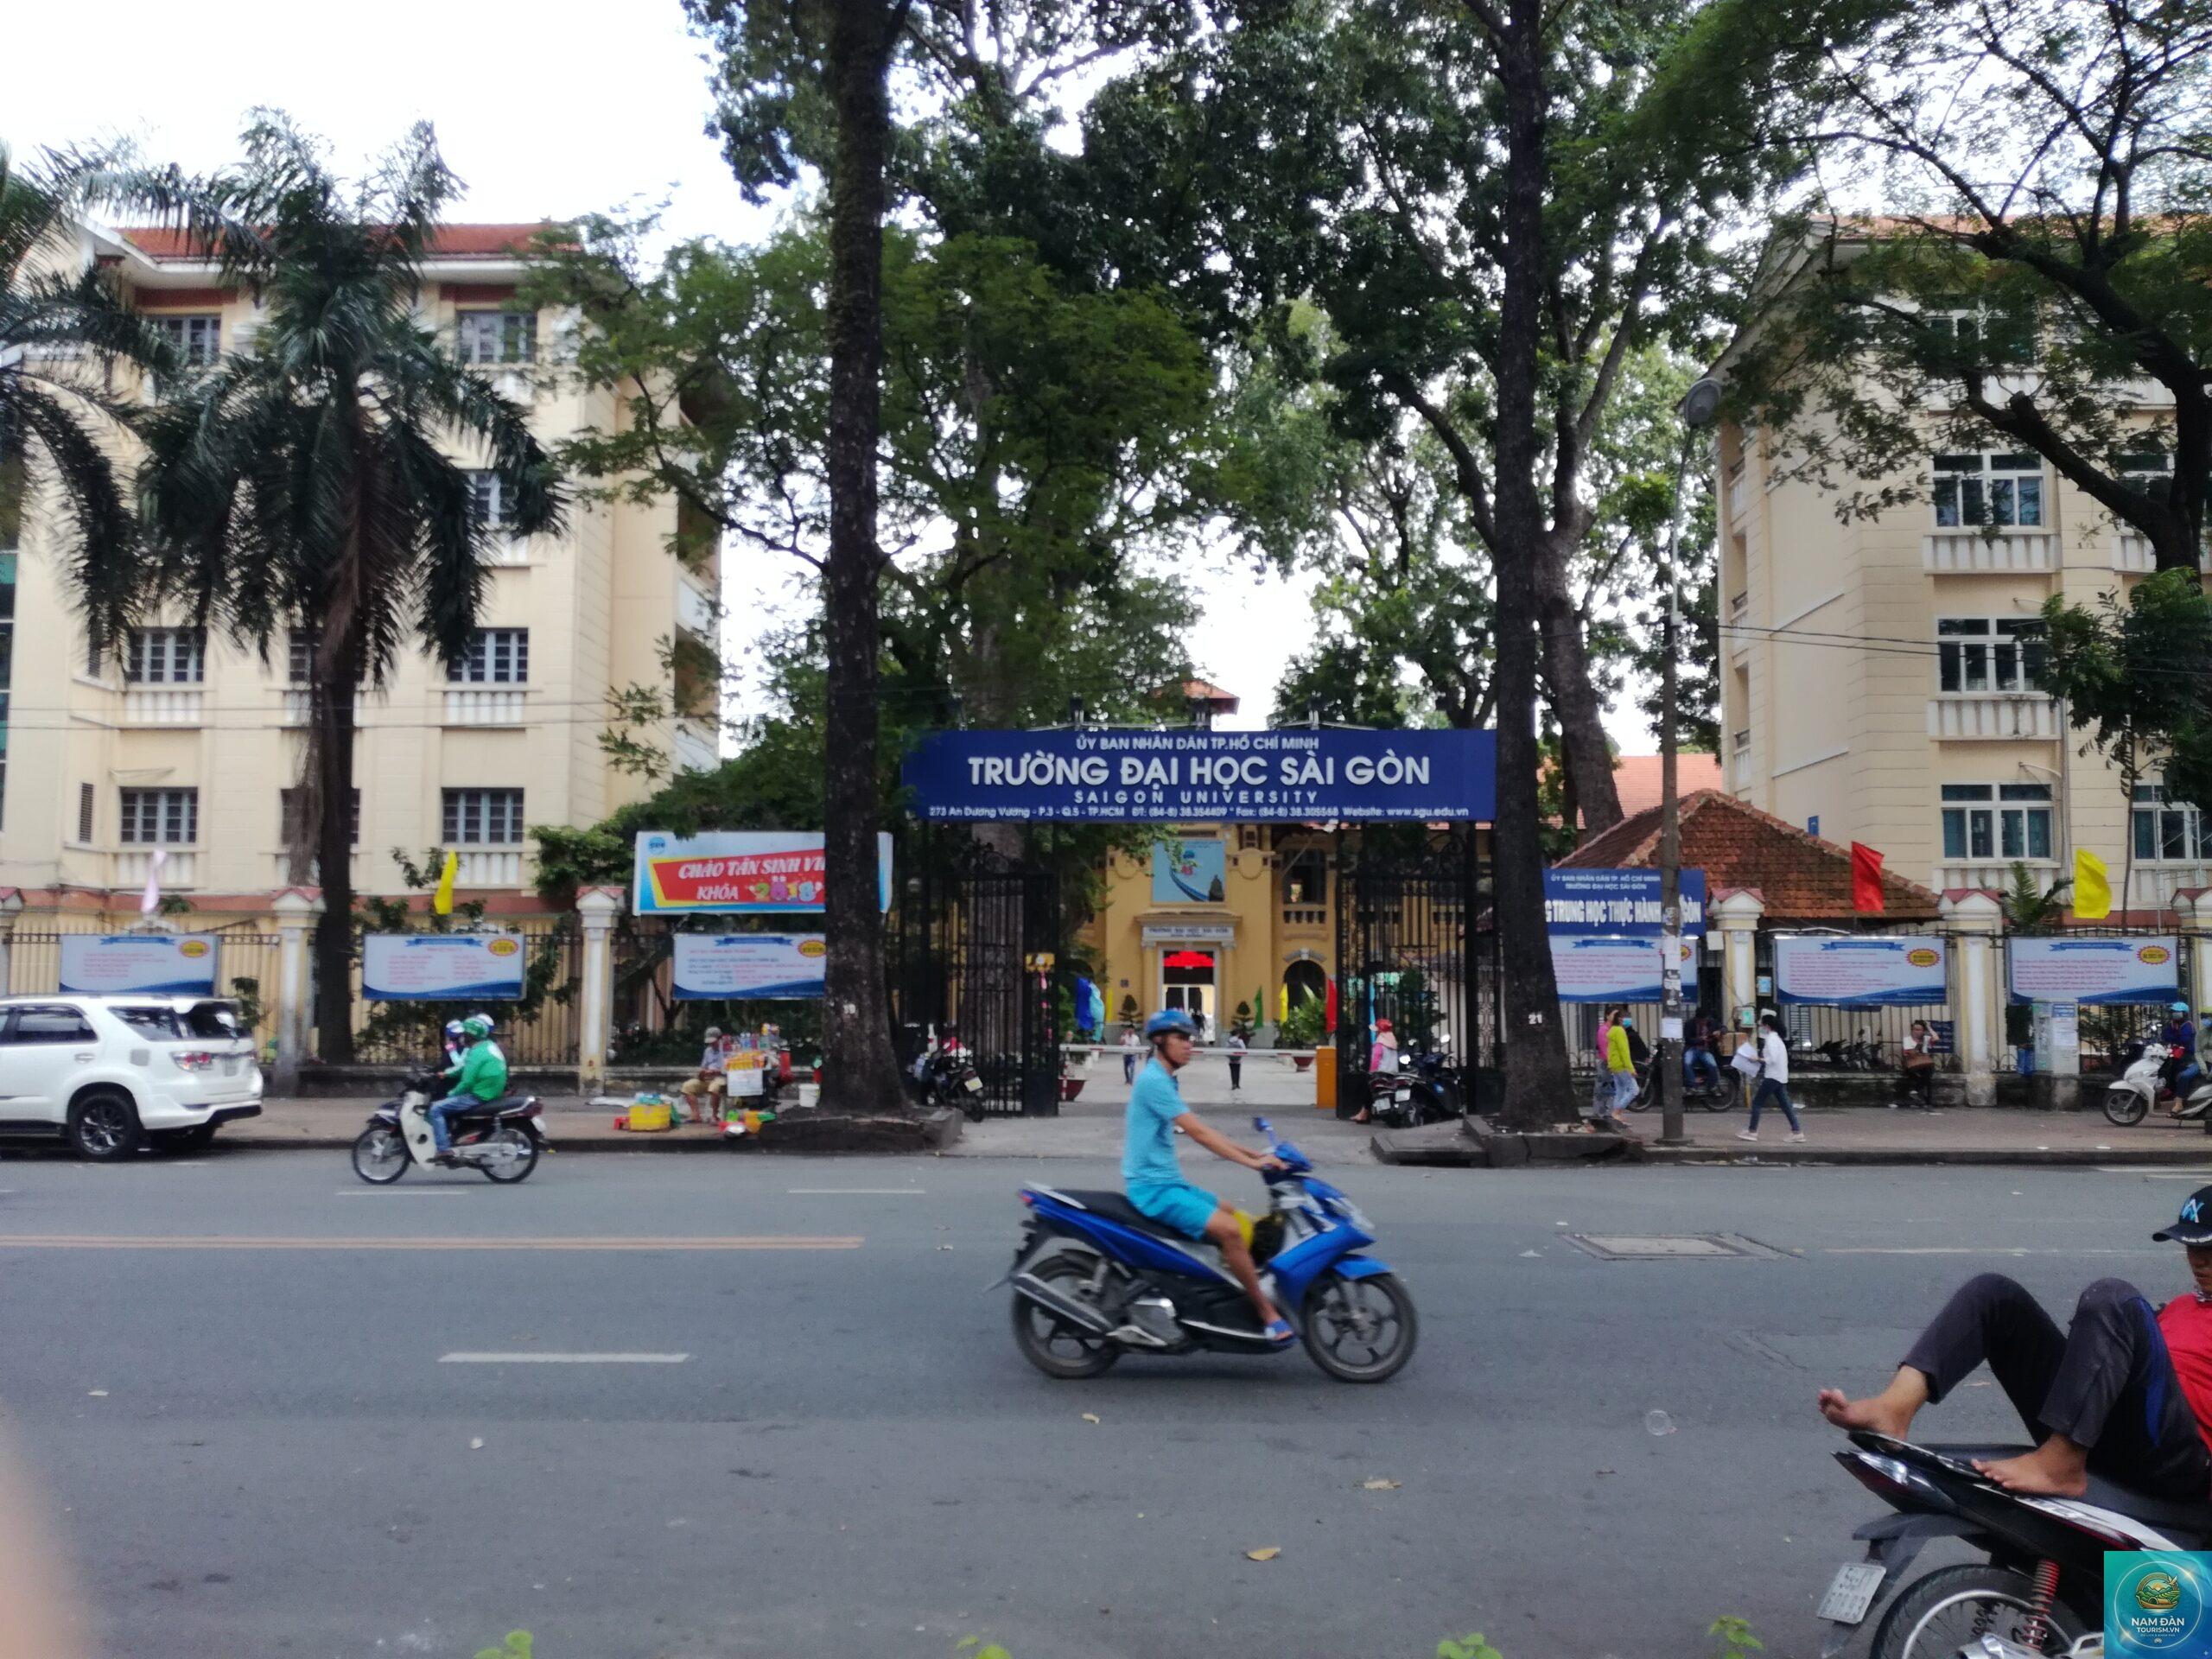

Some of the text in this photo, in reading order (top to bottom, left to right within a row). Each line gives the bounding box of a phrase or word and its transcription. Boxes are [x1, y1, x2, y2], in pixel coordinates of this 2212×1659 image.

[1076, 734, 1096, 750] ỦY
[1100, 737, 1129, 750] BAN
[1132, 734, 1173, 750] NHÂN
[1176, 734, 1207, 750] DÂN
[1253, 734, 1279, 750] CHÍ
[1281, 737, 1319, 750] MINH
[968, 748, 1430, 791] TRƯỜNG ĐẠI HỌC SÀI GÒN
[1074, 791, 1318, 804] SAIGON UNIVERSITY
[929, 806, 947, 817] 273
[949, 806, 963, 817] An
[964, 805, 996, 818] Dương
[998, 805, 1031, 818] Vương
[1088, 806, 1125, 817] TP.HCM
[1342, 806, 1384, 817] Website:
[760, 857, 802, 875] SINH
[696, 882, 739, 900] KHÓA
[1552, 899, 1585, 923] TRUNG
[1586, 899, 1606, 927] HỌC
[1607, 897, 1633, 927] THỰC
[1634, 896, 1662, 923] HÀNH
